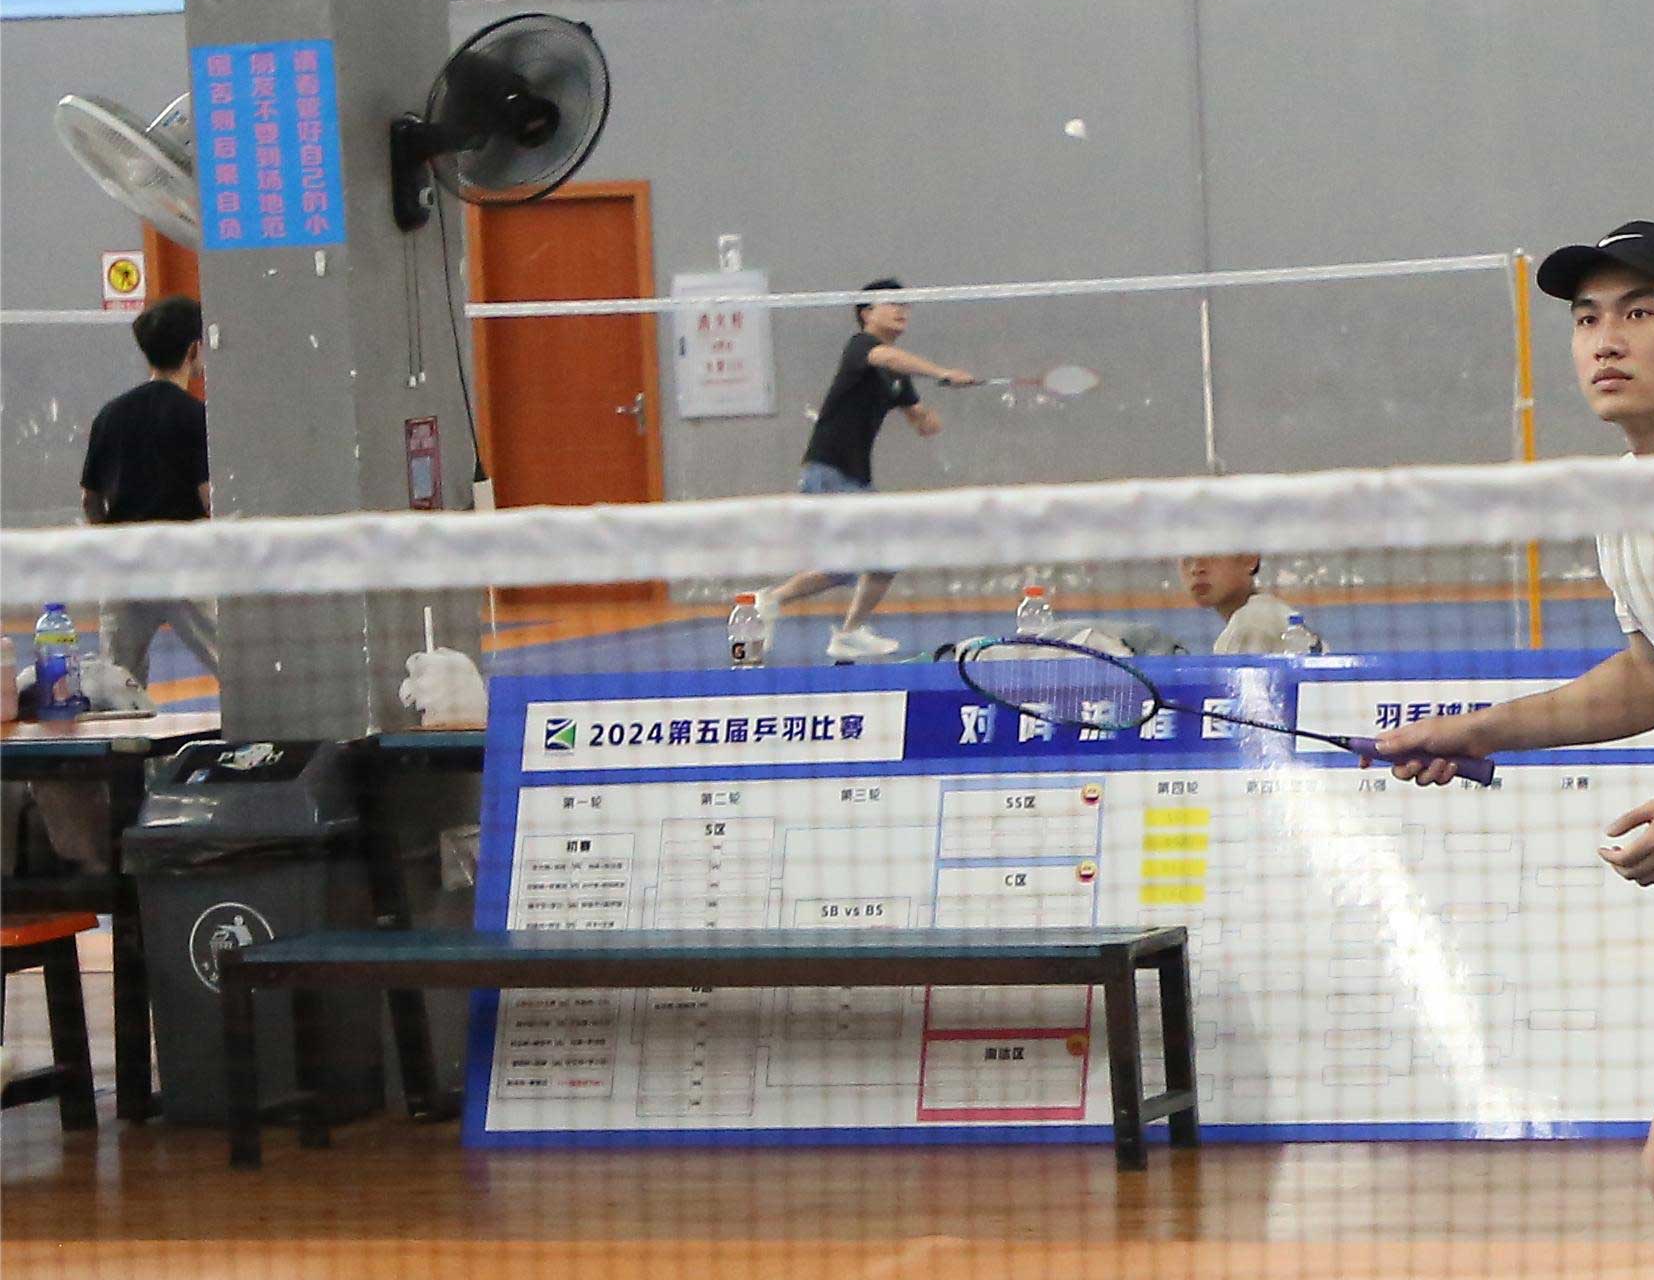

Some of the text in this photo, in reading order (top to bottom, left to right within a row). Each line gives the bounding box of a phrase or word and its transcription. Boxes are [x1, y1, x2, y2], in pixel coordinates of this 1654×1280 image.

[589, 714, 865, 747] 2024第五届乒羽比赛
